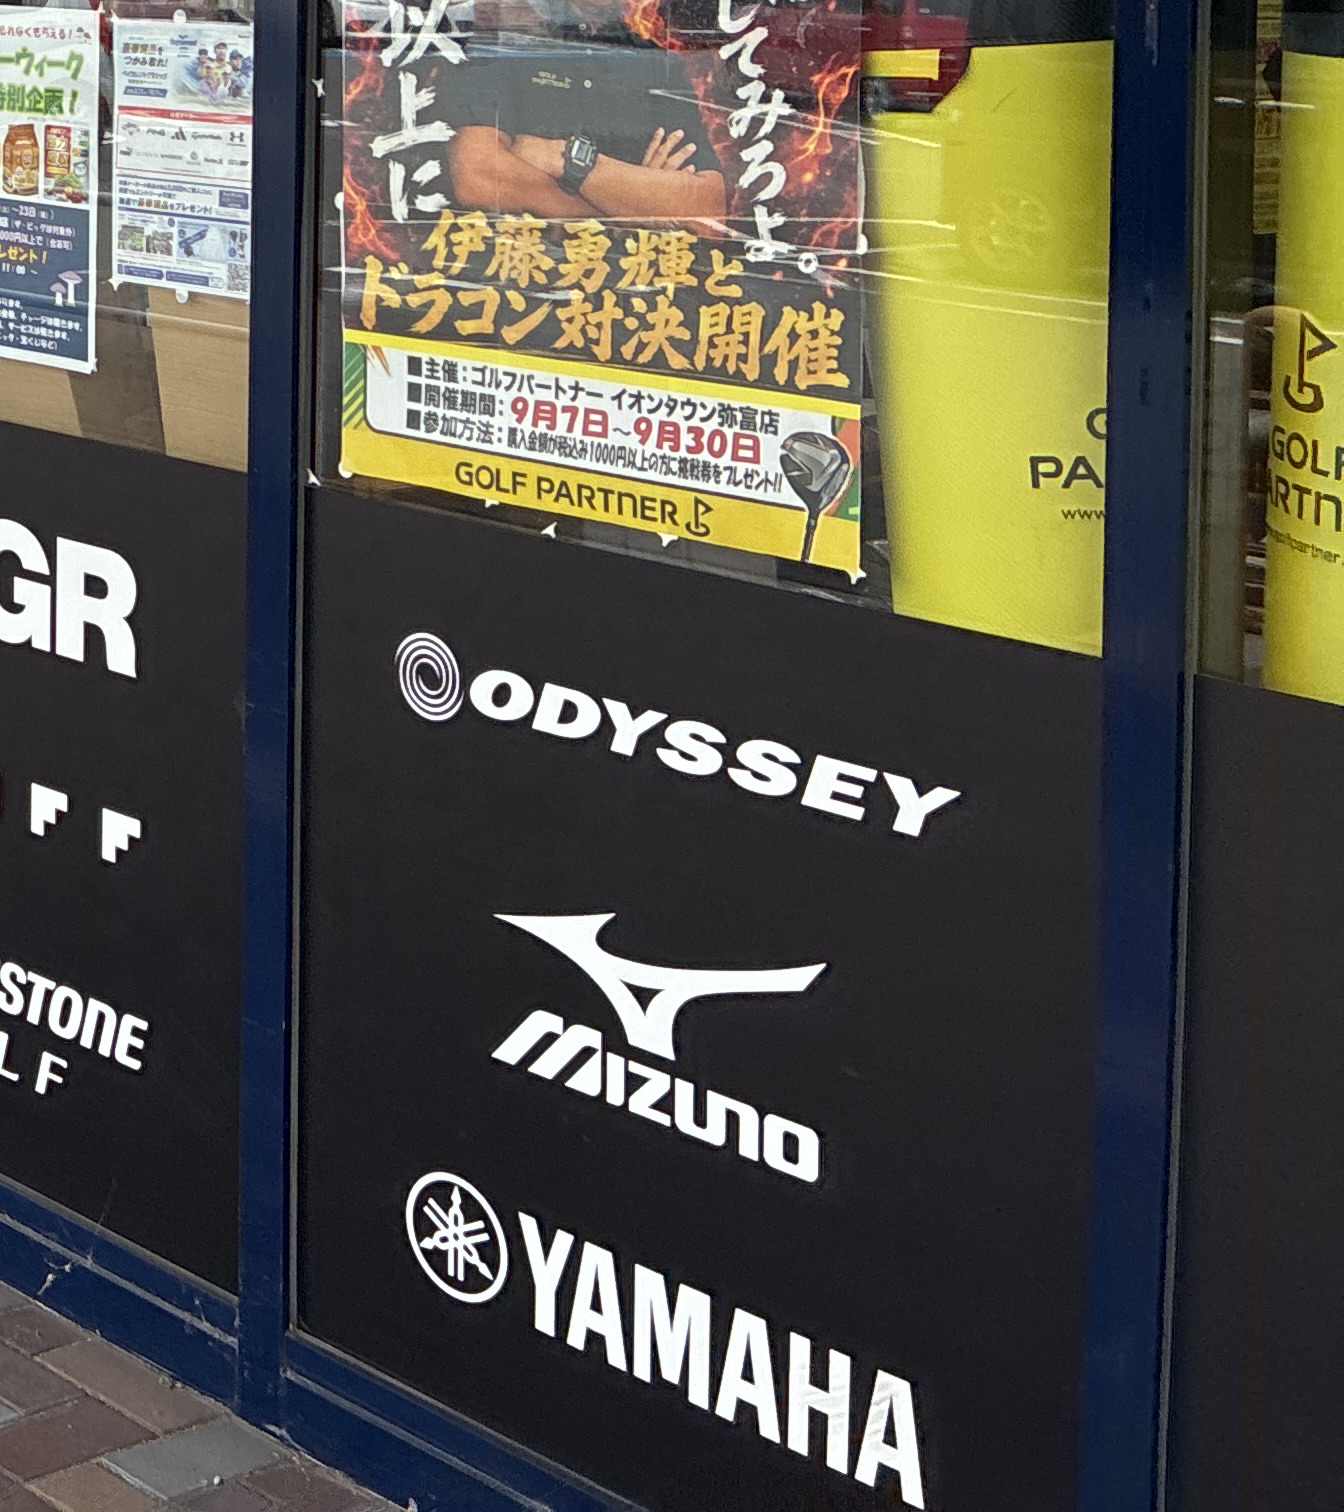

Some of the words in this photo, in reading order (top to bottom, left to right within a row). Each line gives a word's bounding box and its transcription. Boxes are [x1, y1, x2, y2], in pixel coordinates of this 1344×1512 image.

[421, 208, 745, 300] 伊藤勇輝と
[359, 255, 851, 391] ドラコン対決開催
[454, 461, 528, 497] GOLF
[535, 475, 680, 528] PARTNER
[468, 667, 963, 839] ODYSSEY
[516, 1210, 927, 1512] YAMAHA
